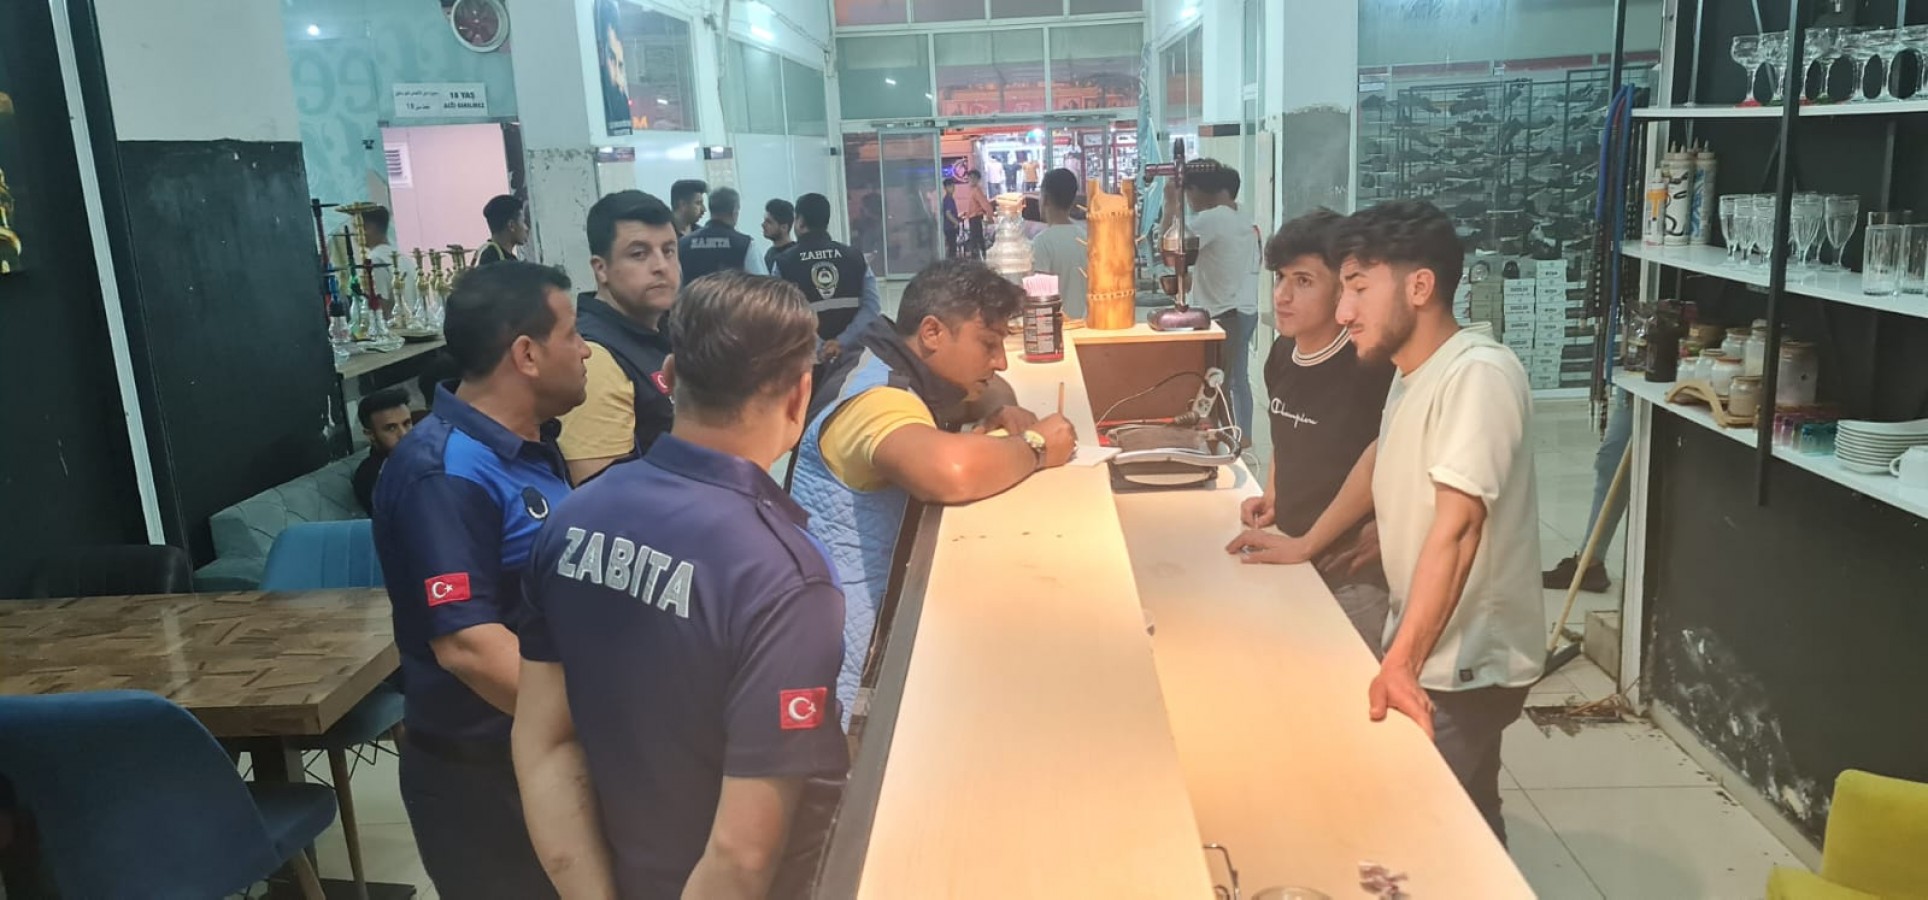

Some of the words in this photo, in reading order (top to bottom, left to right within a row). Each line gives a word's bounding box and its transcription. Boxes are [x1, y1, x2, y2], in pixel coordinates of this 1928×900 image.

[799, 249, 842, 260] ZABITA
[1271, 397, 1318, 428] Champion
[557, 527, 694, 618] ZABITA
